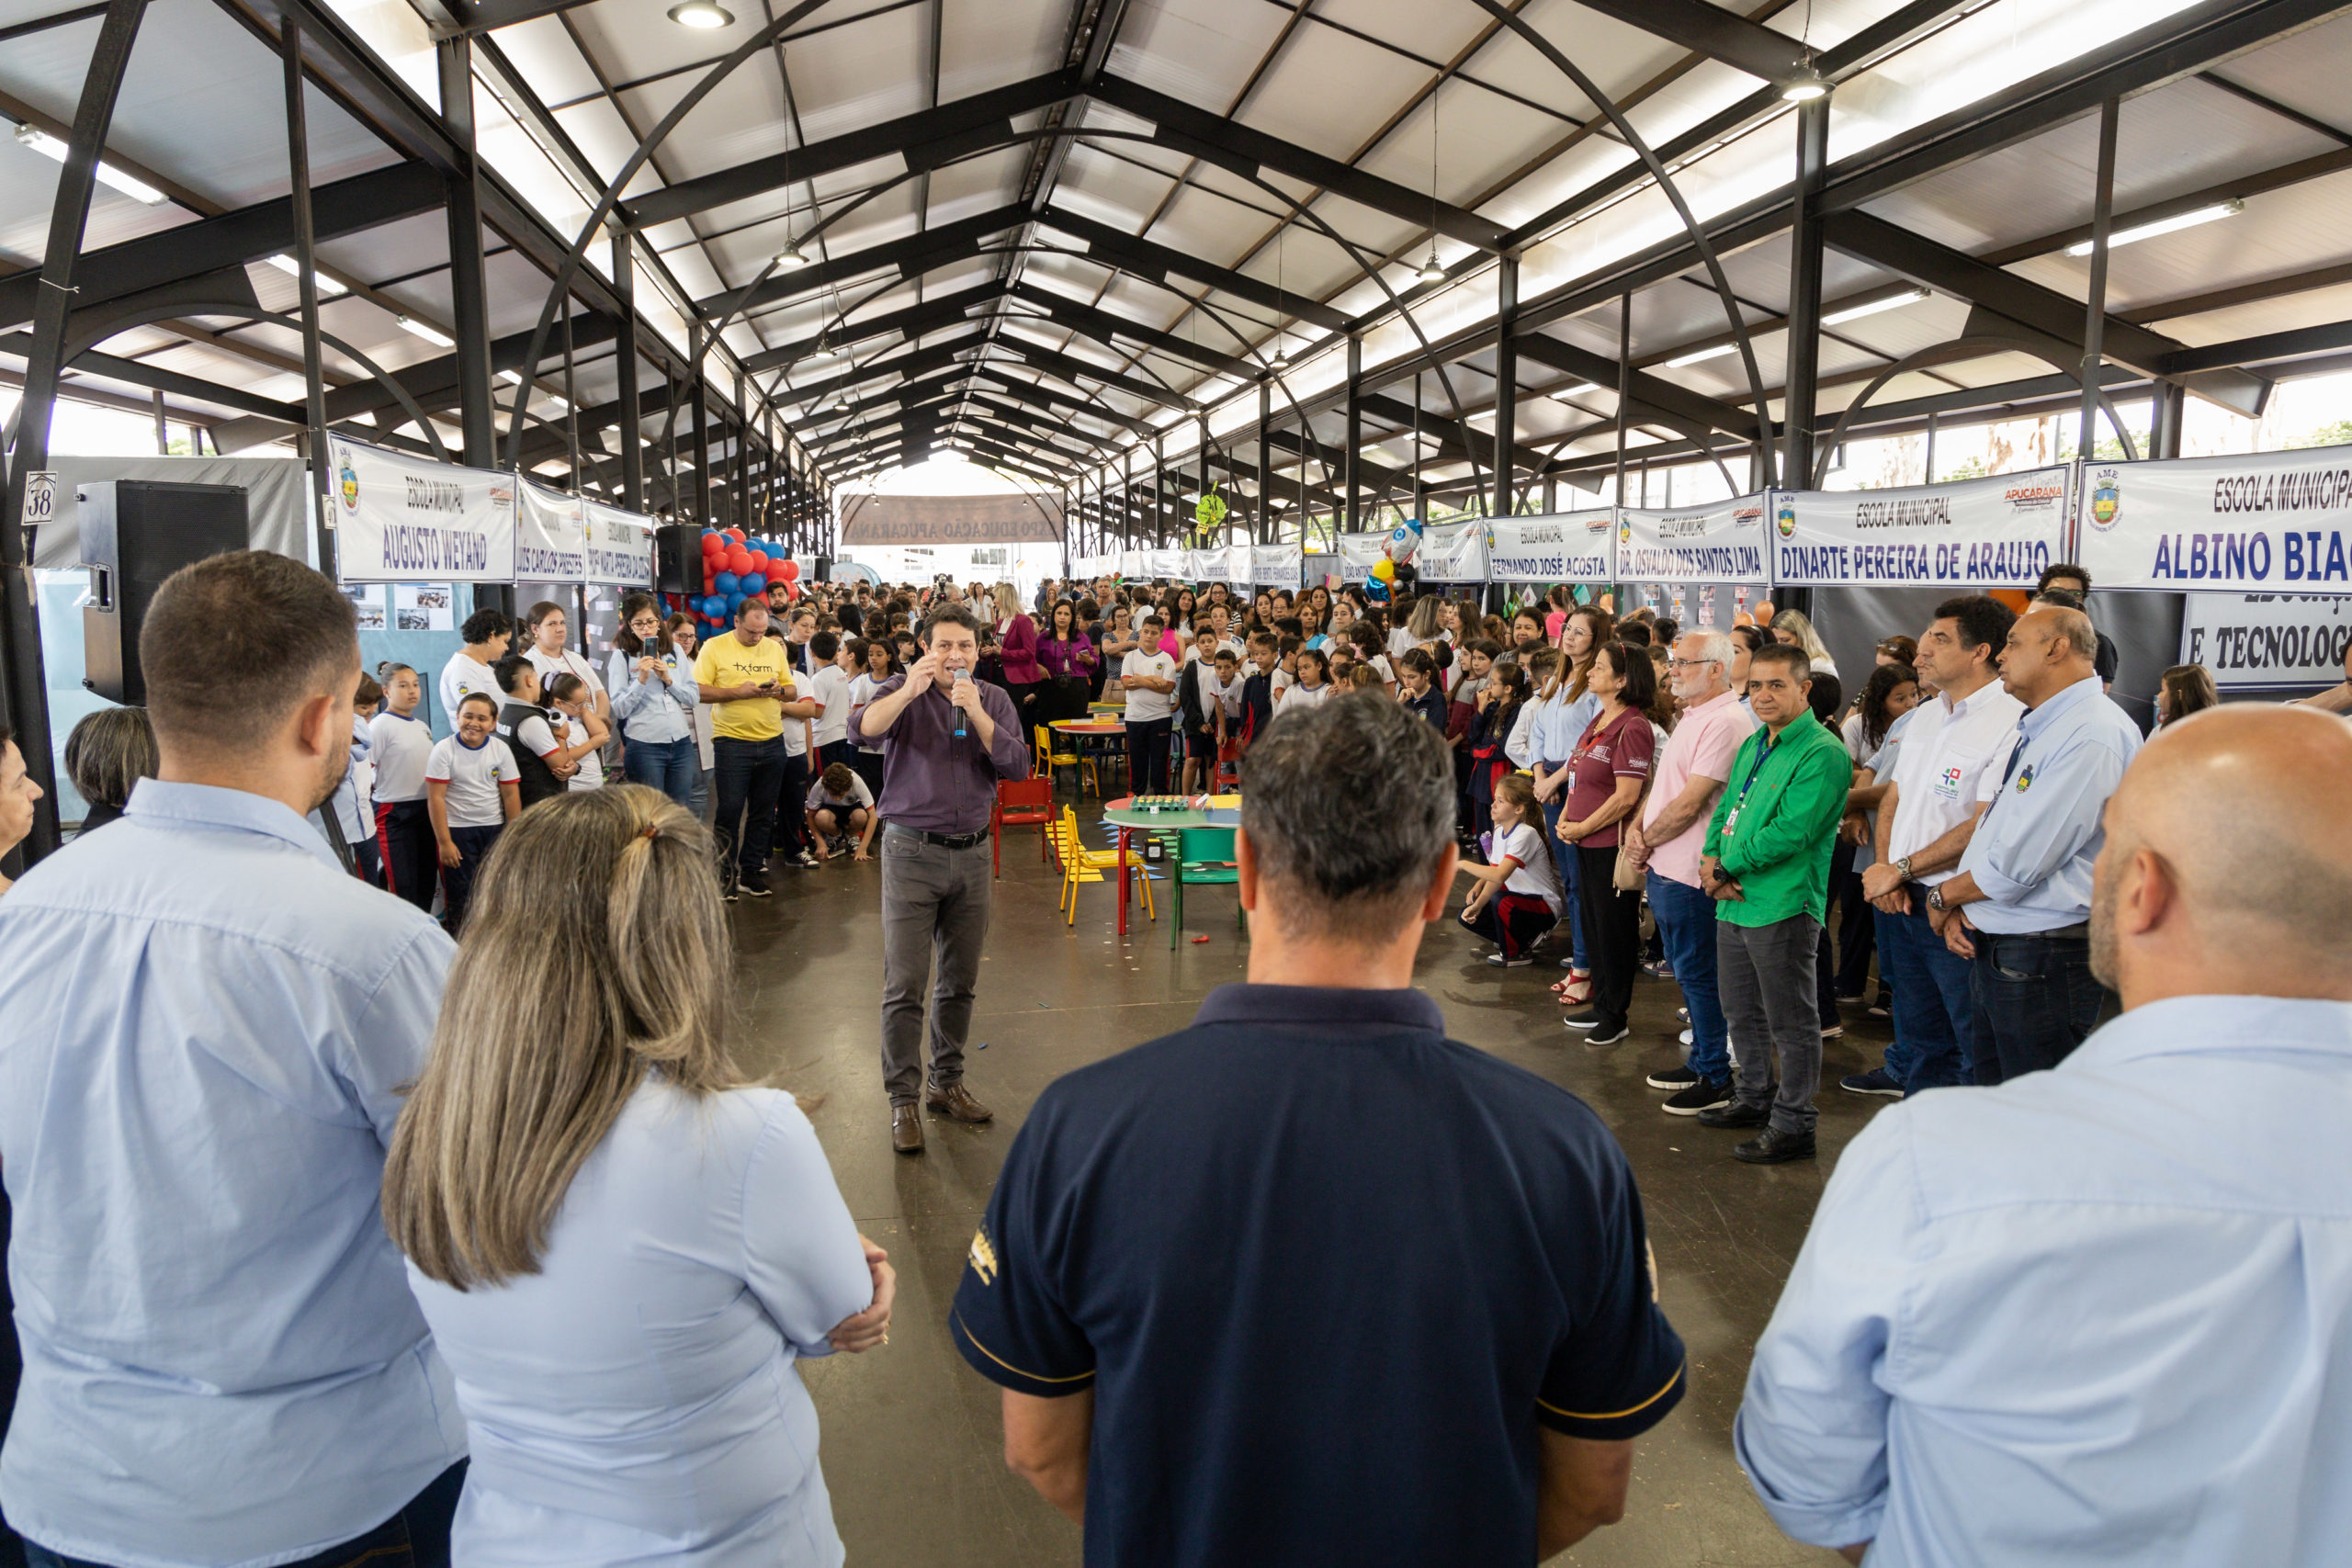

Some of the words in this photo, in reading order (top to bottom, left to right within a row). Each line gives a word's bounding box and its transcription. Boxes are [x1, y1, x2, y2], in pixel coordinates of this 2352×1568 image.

[2096, 468, 2119, 480] AME
[28, 489, 51, 516] 38
[406, 476, 432, 508] ESCOLA
[2005, 486, 2063, 500] APUCARANA
[2214, 474, 2273, 513] ESCOLA
[1659, 517, 1679, 538] ESCOLA
[1856, 502, 1894, 528] ESCOLA
[1896, 496, 1951, 526] MUNICIPAL
[383, 524, 439, 570] AUGUSTO
[441, 529, 487, 570] WEYAND
[1521, 526, 1538, 544] ESCOLA
[531, 548, 557, 573] CARLOS
[1492, 558, 1537, 576] FERNANDO
[1540, 551, 1563, 576] JOSÉ
[1566, 557, 1606, 576] ACOSTA
[1620, 550, 1633, 576] DR.
[1634, 548, 1673, 576] OSVALDO
[1676, 548, 1695, 577] DOS
[1696, 546, 1734, 577] SANTOS
[1734, 546, 1762, 576] LIMA
[1781, 546, 1849, 579] DINARTE
[1854, 543, 1929, 579] PEREIRA
[1936, 543, 1962, 580] DE
[1967, 540, 2049, 581] ARAUJO
[2152, 531, 2271, 581] ALBINO
[2284, 531, 2352, 581] BIA
[2190, 627, 2205, 665] E
